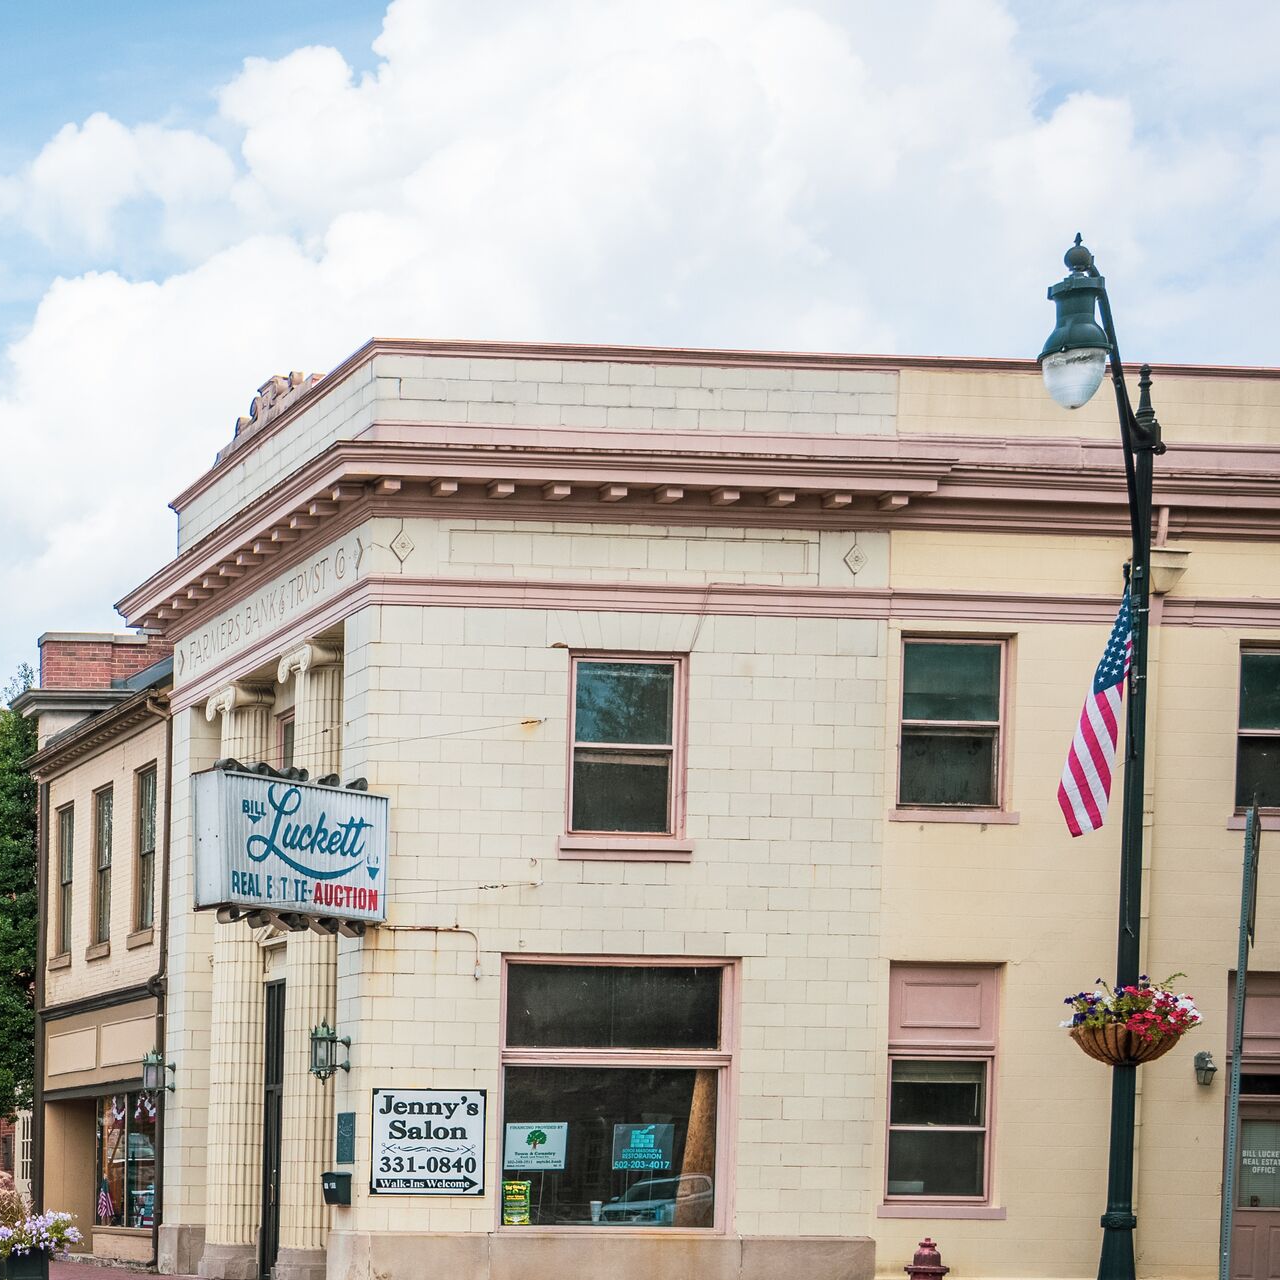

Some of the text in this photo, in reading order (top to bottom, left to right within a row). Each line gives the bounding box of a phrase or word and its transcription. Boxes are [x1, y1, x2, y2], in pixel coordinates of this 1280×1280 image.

[189, 613, 241, 671] FARMERS
[244, 592, 276, 636] BANK
[242, 799, 267, 816] BILL
[247, 784, 375, 880] Luckett
[231, 870, 262, 898] REAL
[313, 881, 379, 912] AUCTION
[379, 1095, 479, 1120] Jenny's
[388, 1120, 468, 1140] Salon
[379, 1156, 477, 1174] 331-0840
[614, 1160, 671, 1169] 502-203-4017
[1252, 1166, 1276, 1174] OFFICE
[380, 1178, 470, 1189] Walk-Ins Welcome
